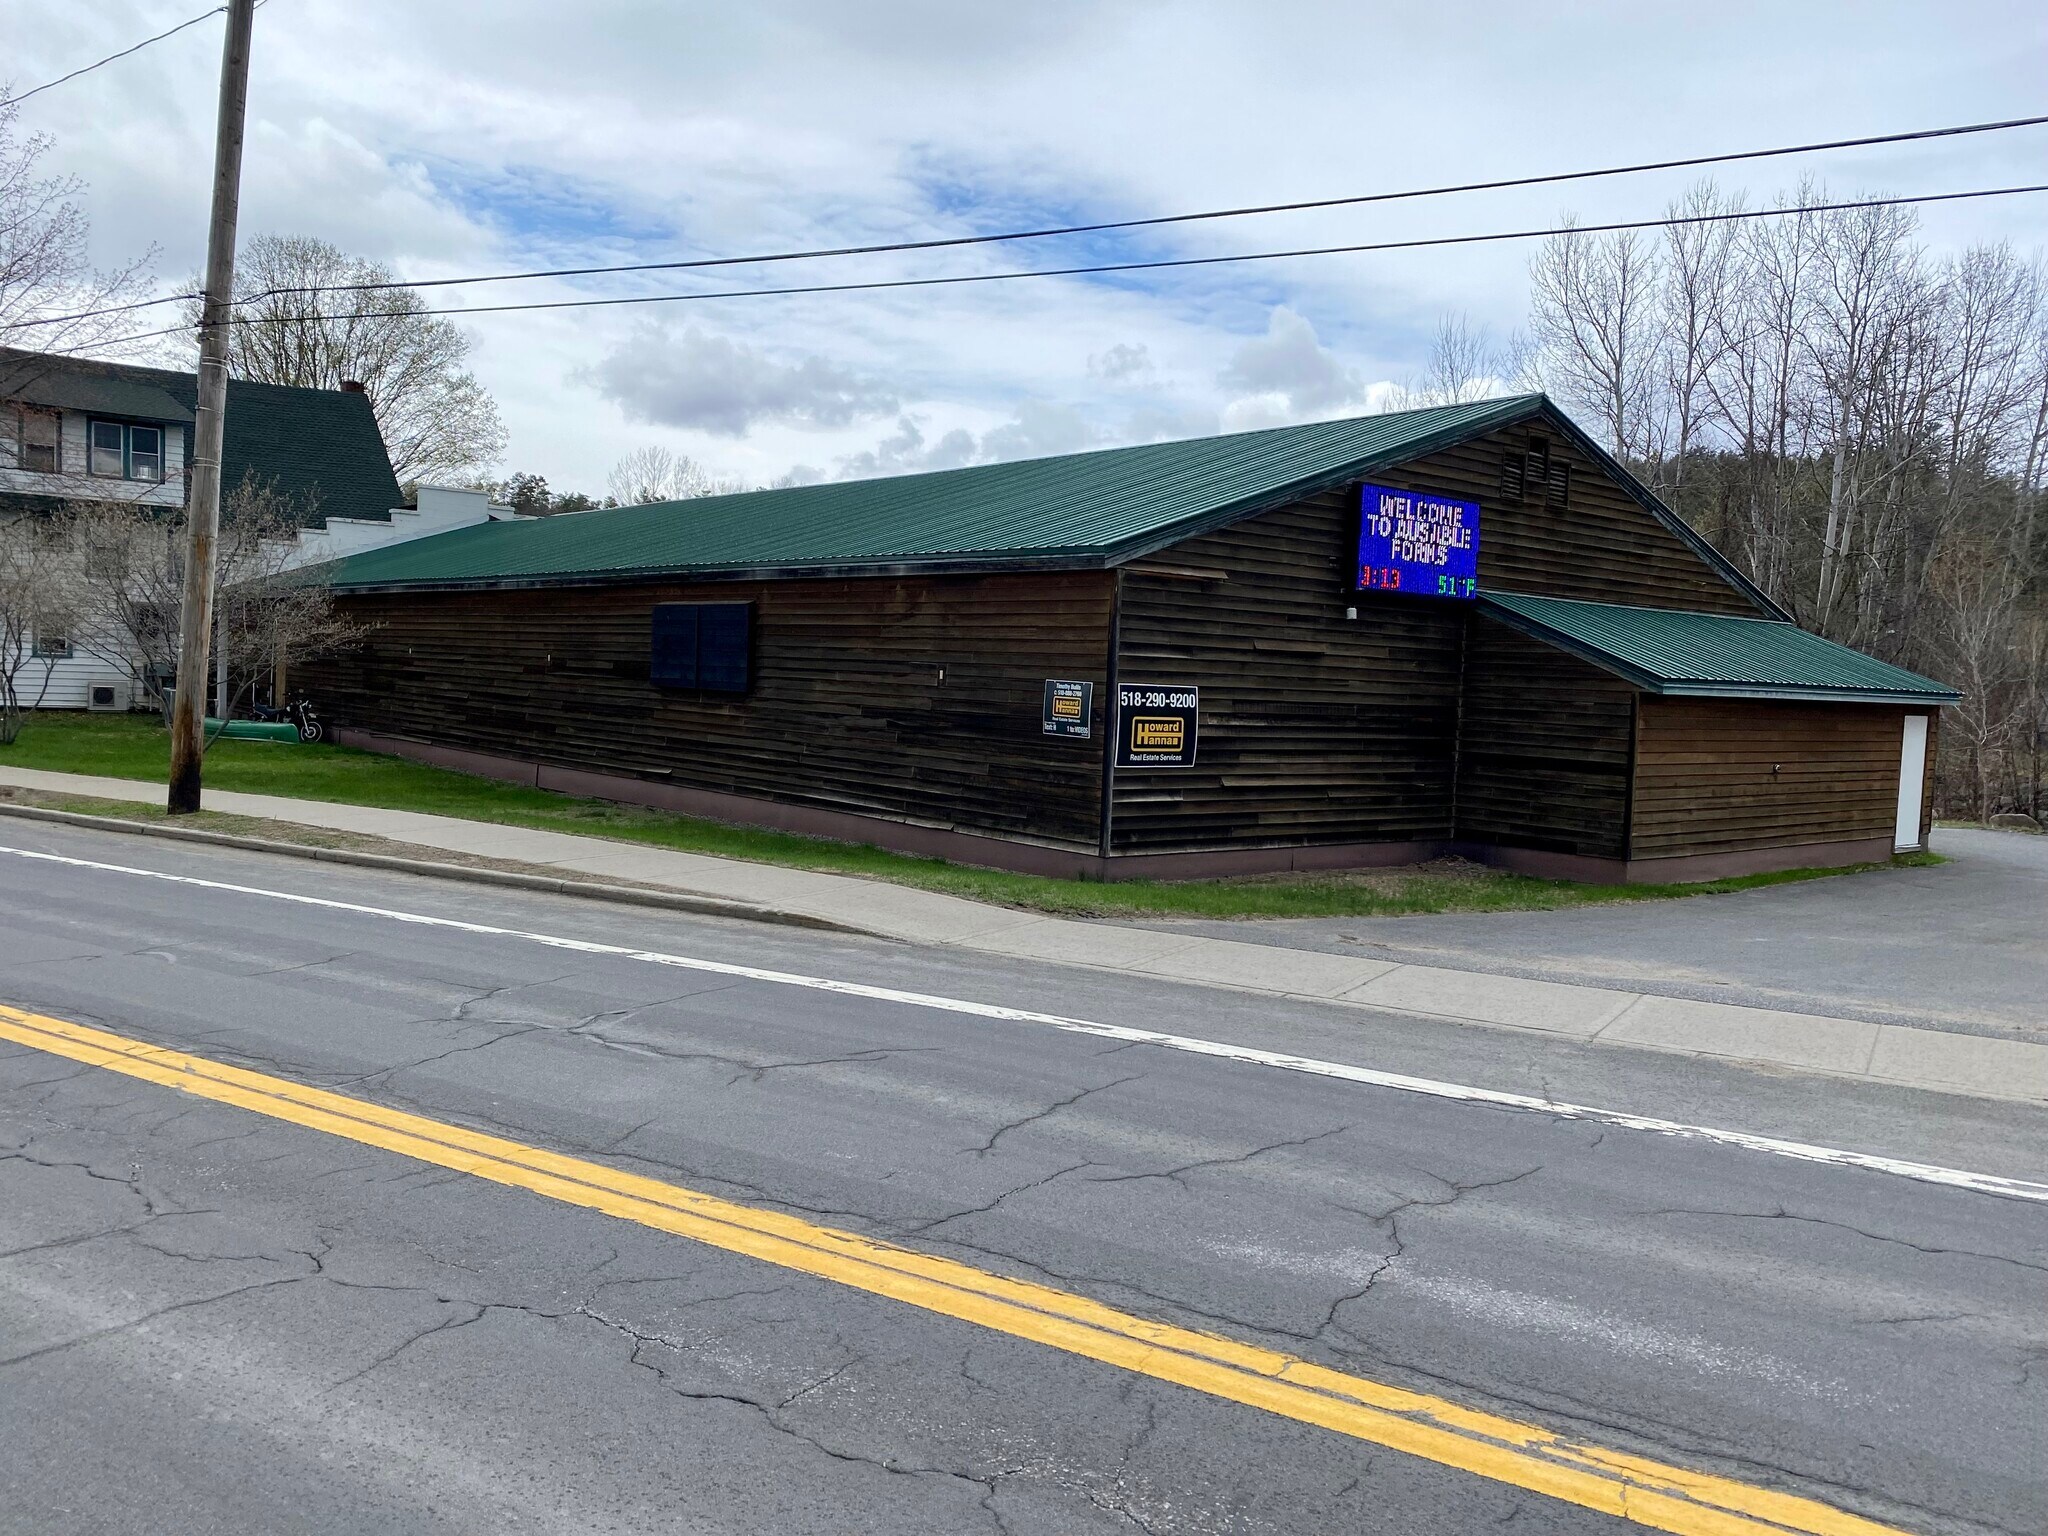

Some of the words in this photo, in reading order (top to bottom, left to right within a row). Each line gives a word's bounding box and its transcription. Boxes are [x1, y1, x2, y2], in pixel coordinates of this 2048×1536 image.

[1380, 495, 1463, 527] WELCOME
[1367, 514, 1391, 537] TO
[1121, 692, 1195, 708] 518-290-9200
[1137, 722, 1180, 737] Howard
[1136, 731, 1178, 745] Hanna
